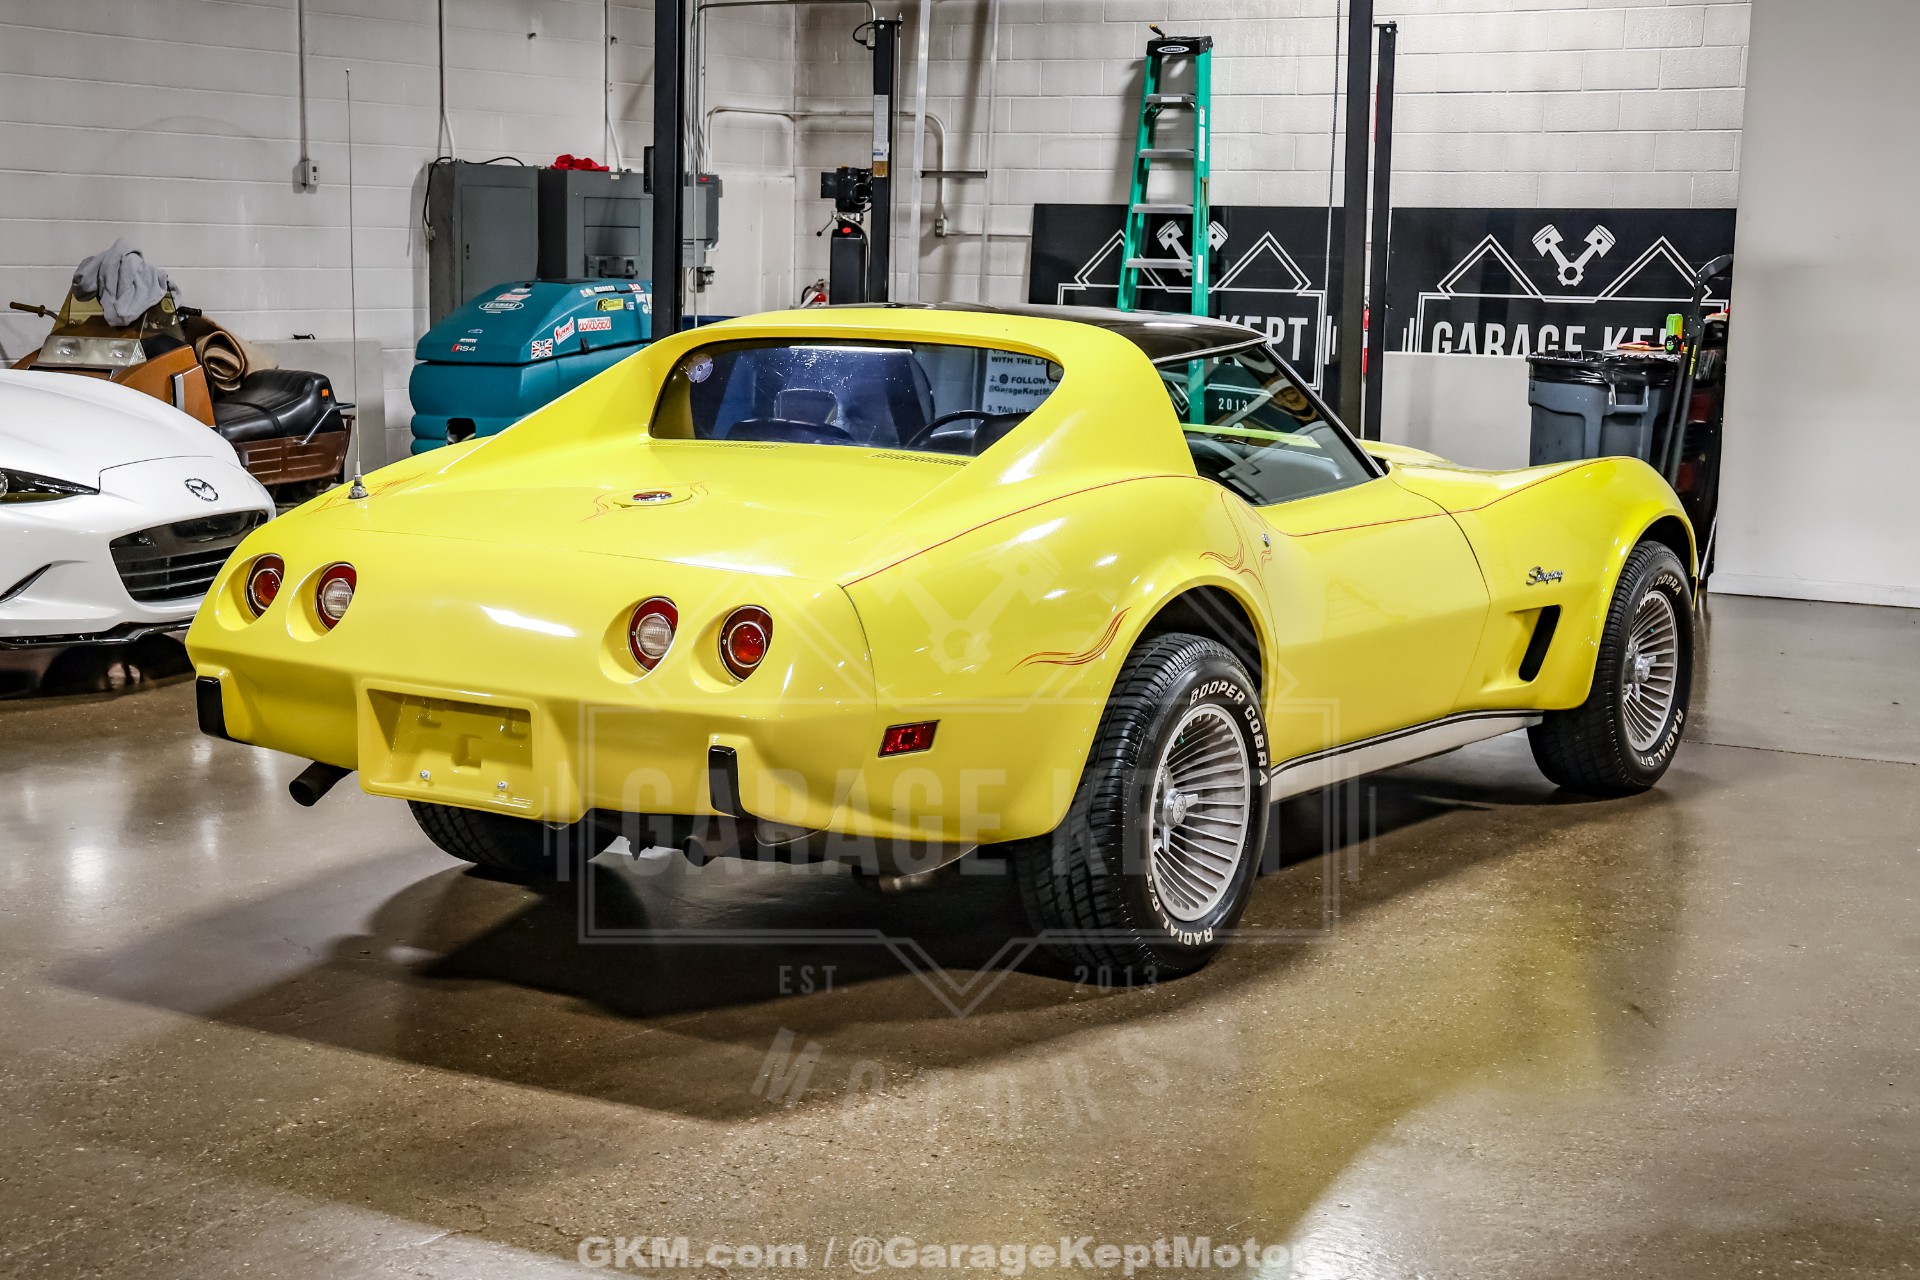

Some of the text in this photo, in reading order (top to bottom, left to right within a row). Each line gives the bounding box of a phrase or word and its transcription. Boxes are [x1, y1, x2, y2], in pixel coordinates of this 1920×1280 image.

[1431, 321, 1586, 356] GARAGE
[991, 356, 1013, 364] WITH
[989, 384, 1052, 396] @GarageKeptM
[1011, 376, 1046, 384] FOLLOW
[1218, 397, 1248, 412] 2013
[1655, 574, 1682, 595] COBRA
[1244, 704, 1269, 787] COBRA
[1654, 708, 1684, 762] RADIAL
[1162, 912, 1214, 946] RADIAL
